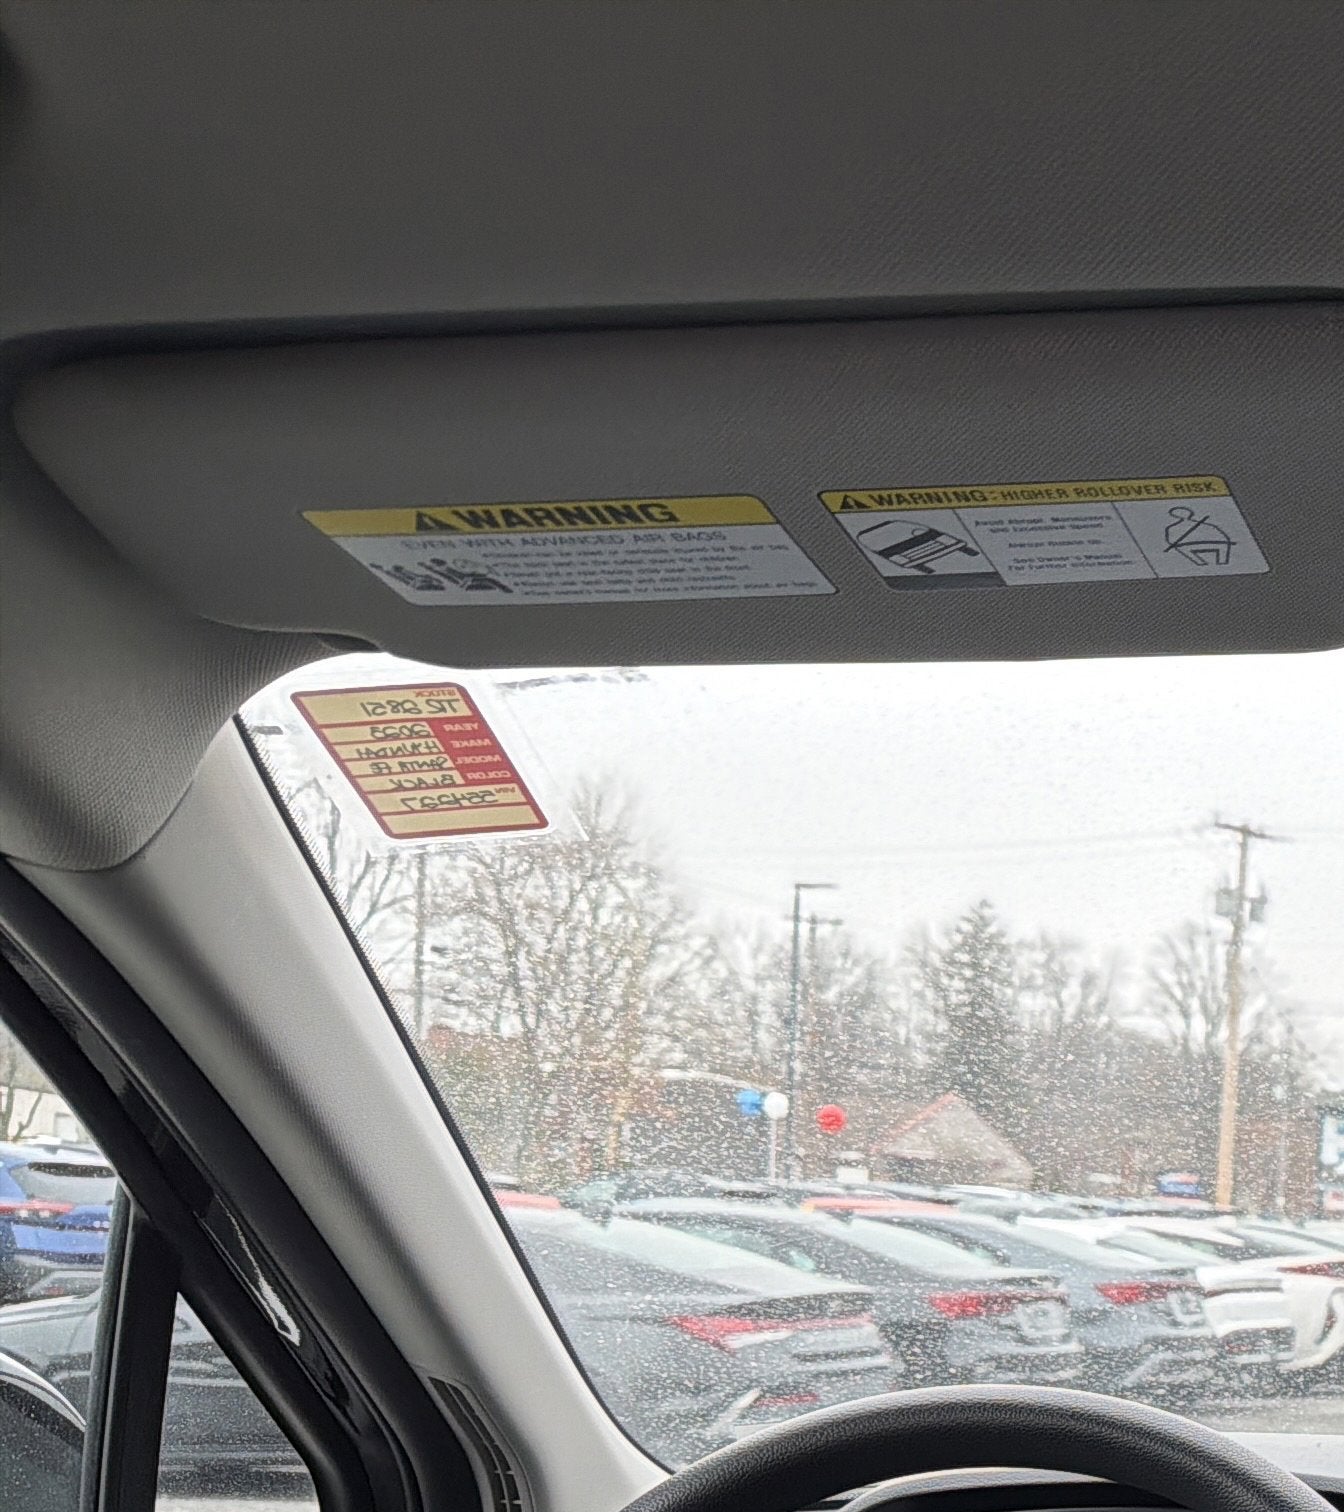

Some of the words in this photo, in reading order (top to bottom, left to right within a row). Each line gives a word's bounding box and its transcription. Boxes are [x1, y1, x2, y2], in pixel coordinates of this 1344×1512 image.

[1001, 488, 1068, 502] HIGHER
[1073, 484, 1167, 499] ROLLOVER
[1172, 481, 1214, 494] RISK
[451, 503, 680, 529] WARNING
[464, 538, 512, 549] WITH
[521, 534, 624, 547] ADVANCED
[633, 533, 665, 544] AIR
[671, 531, 727, 542] BAGS
